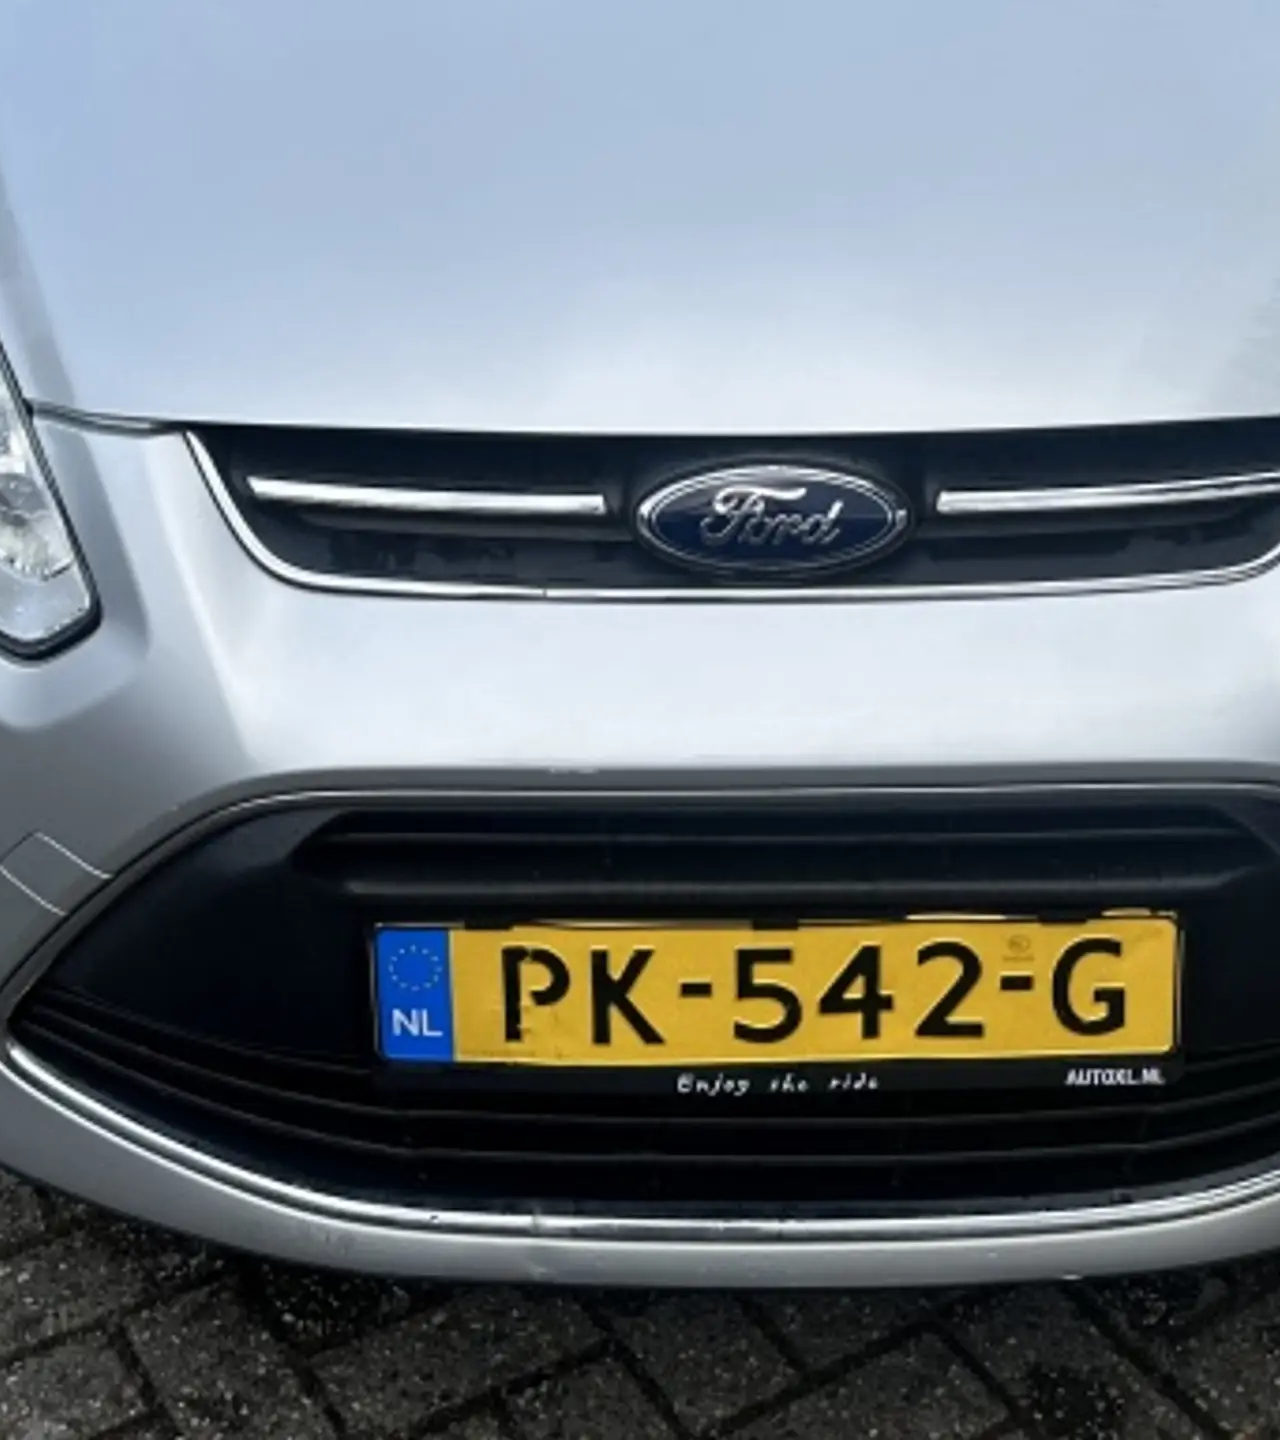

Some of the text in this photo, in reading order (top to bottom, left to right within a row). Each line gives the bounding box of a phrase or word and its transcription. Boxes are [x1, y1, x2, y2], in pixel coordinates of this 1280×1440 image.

[700, 485, 845, 545] Ford
[500, 936, 1127, 1046] PK-542-G
[391, 1008, 444, 1037] NL
[676, 1072, 879, 1095] Enjoy the ride
[1065, 1068, 1166, 1087] AUTOXL.NL
